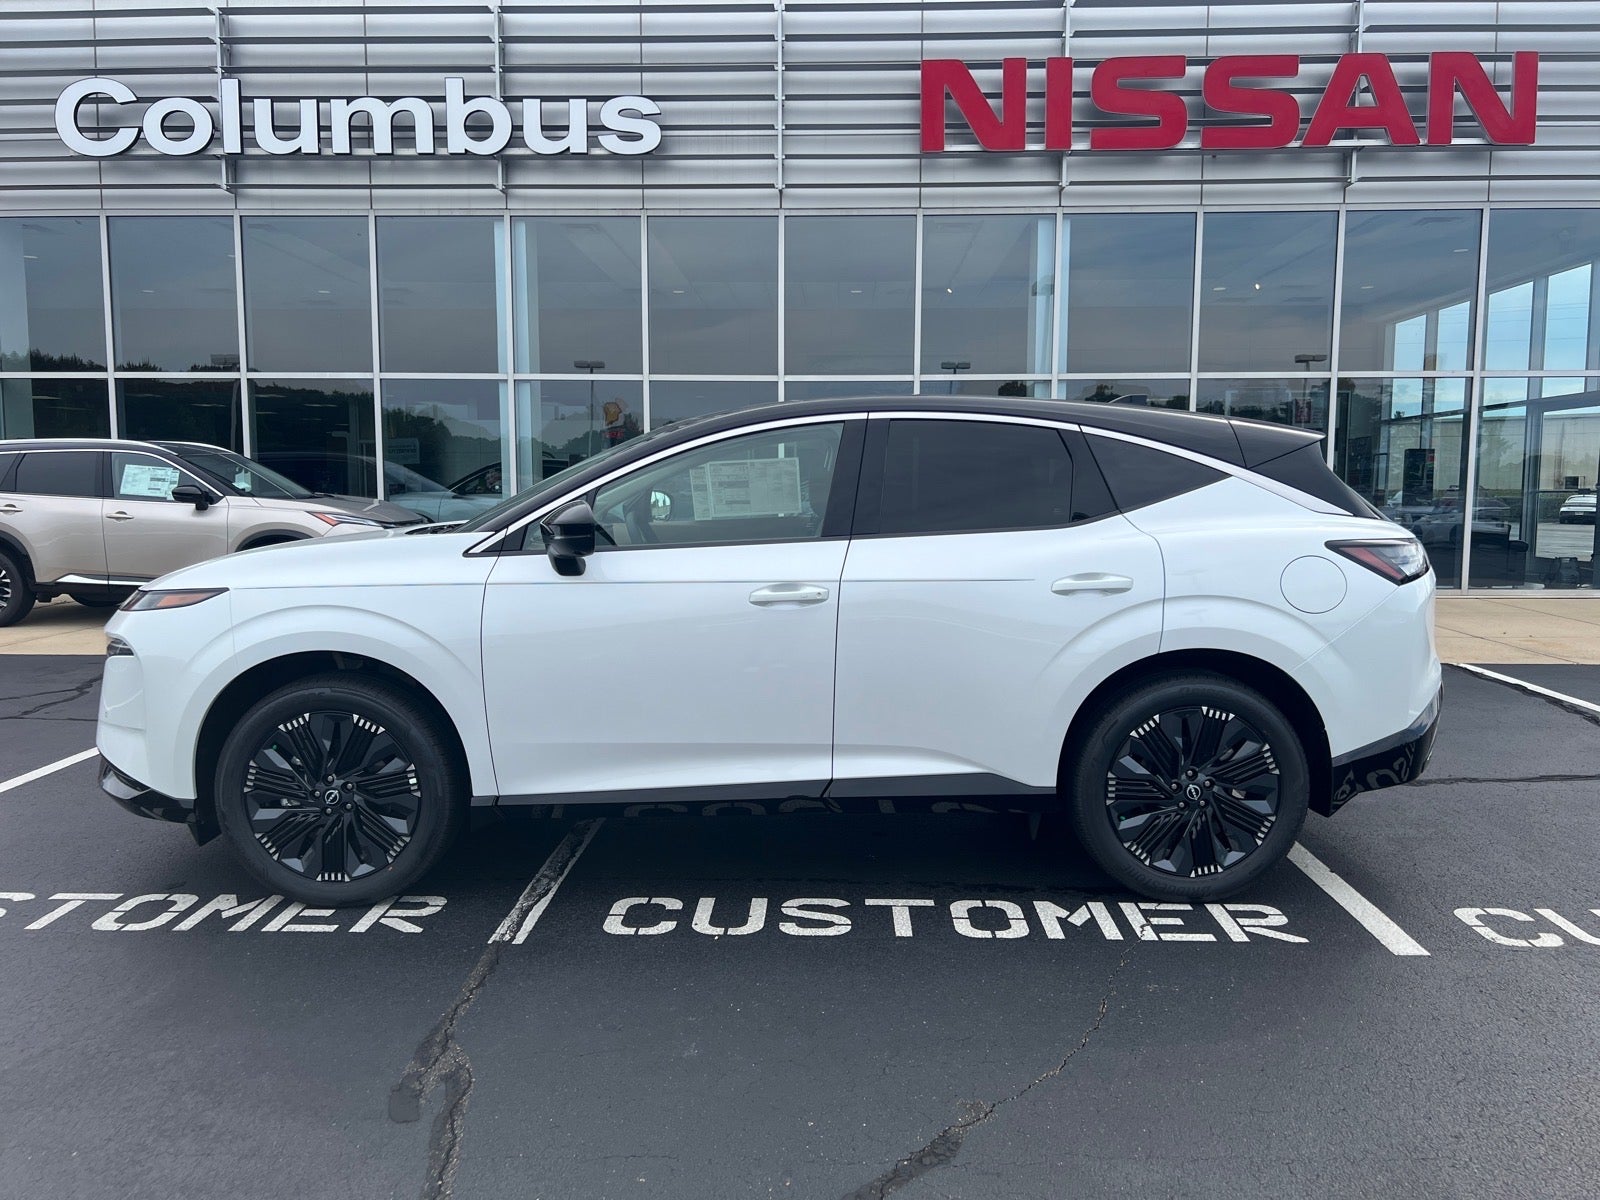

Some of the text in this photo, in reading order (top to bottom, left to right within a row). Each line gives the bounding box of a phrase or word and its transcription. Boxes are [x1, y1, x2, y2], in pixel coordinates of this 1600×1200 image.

[54, 77, 662, 157] Columbus
[920, 51, 1538, 153] NISSAN
[602, 897, 1310, 943] CUSTOMER
